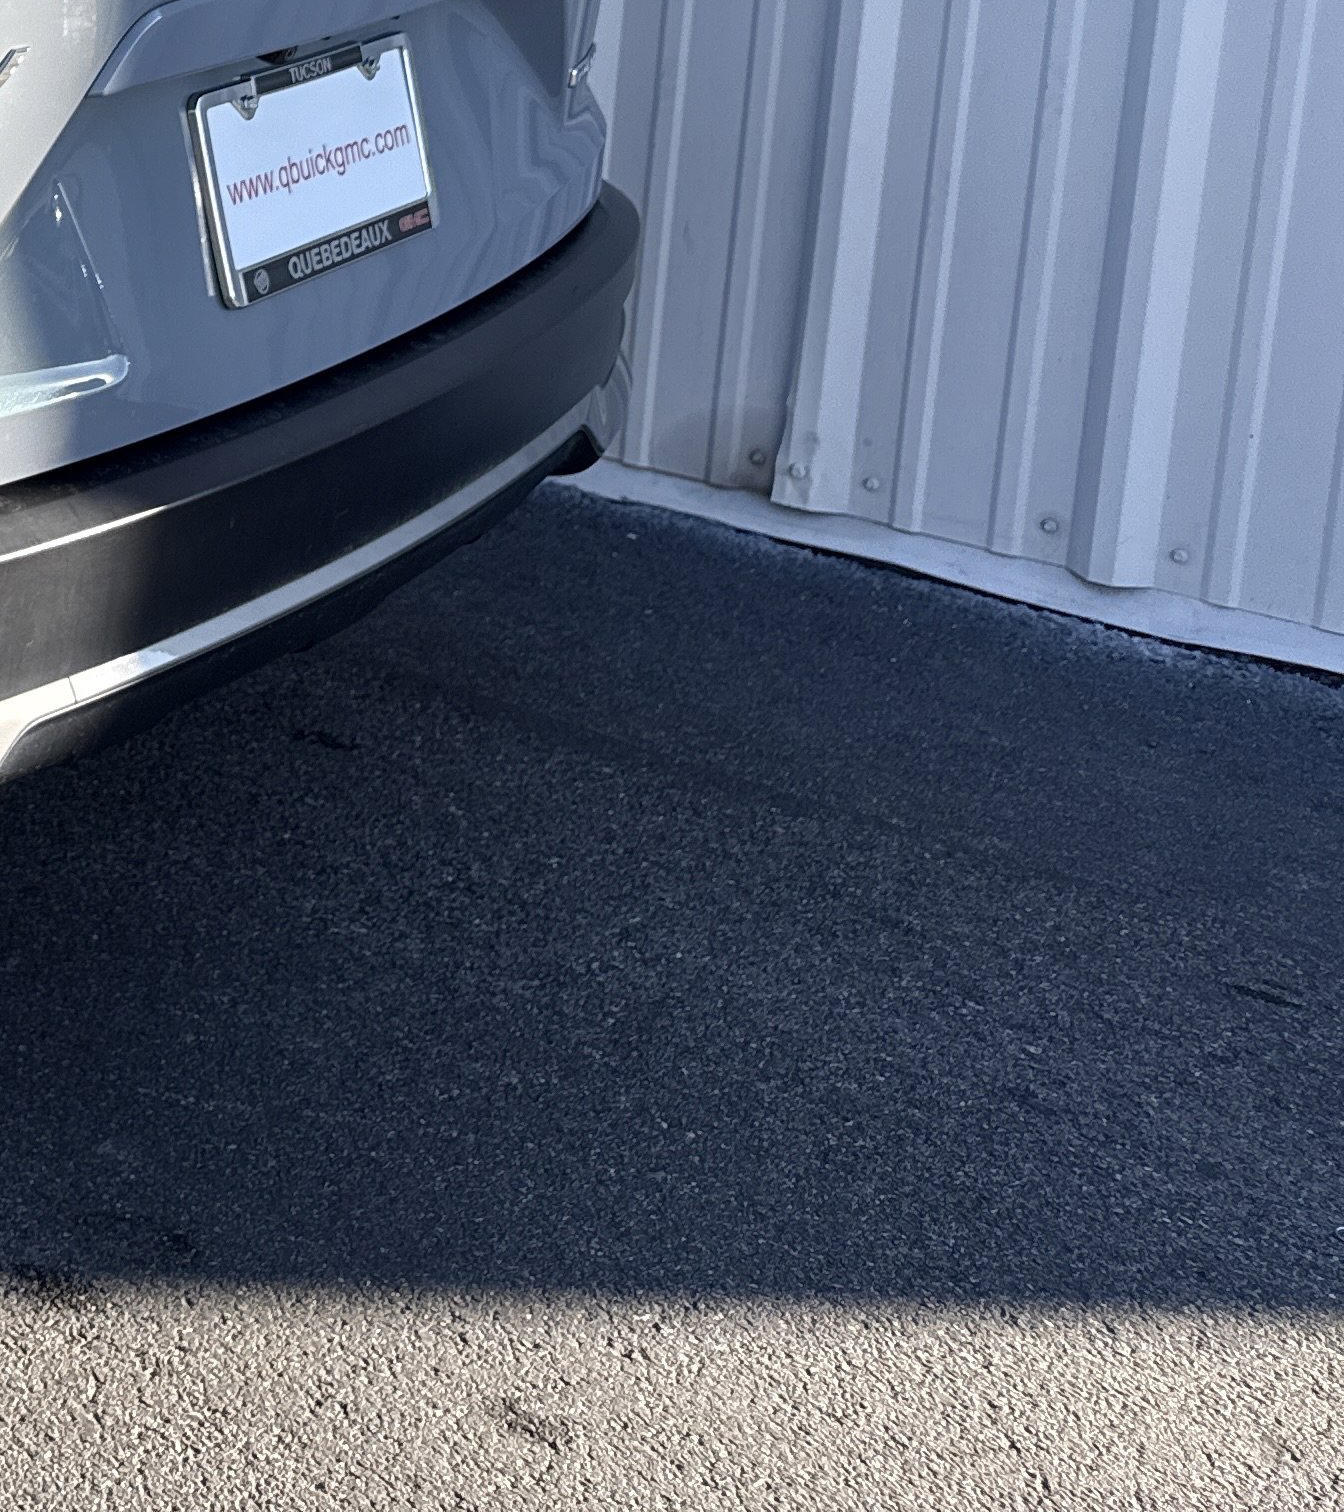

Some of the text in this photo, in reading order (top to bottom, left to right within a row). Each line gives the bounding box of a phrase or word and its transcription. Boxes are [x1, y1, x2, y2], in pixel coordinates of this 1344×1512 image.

[288, 56, 332, 84] TUCSON
[226, 123, 411, 206] www.qbuickgmc.com
[287, 218, 393, 279] QUEBEDEAUX
